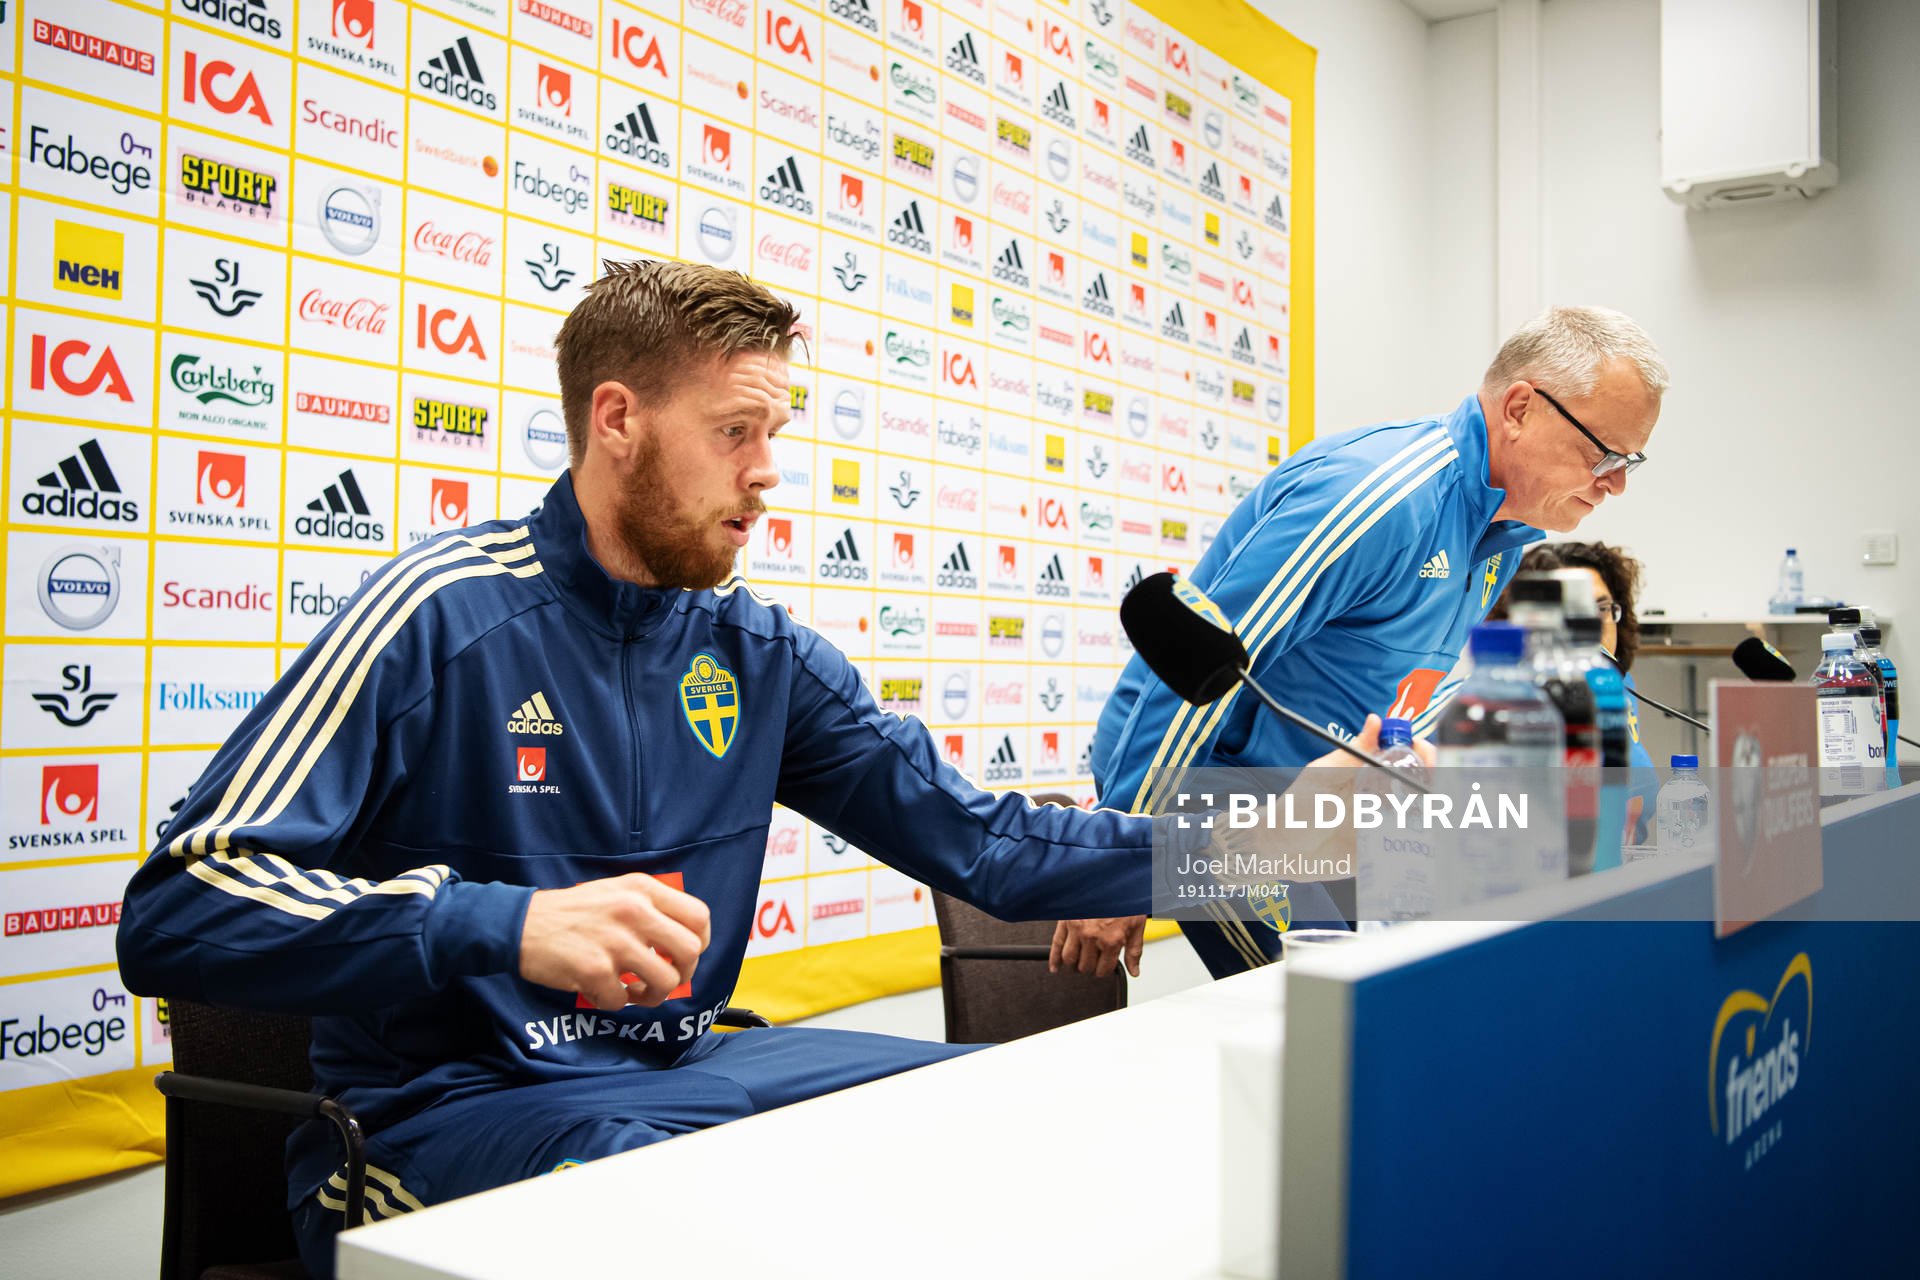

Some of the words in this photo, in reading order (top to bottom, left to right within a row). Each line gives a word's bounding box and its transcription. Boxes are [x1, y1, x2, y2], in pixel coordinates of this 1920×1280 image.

[34, 19, 154, 76] BAUHAUS
[612, 19, 667, 78] ICA
[766, 9, 813, 64] ICA
[1043, 19, 1073, 63] ICA
[308, 37, 364, 64] SVENSKA
[369, 57, 397, 76] SPEL
[183, 50, 273, 126] ICA
[418, 71, 497, 110] adidas
[303, 100, 398, 148] Scandic
[518, 108, 564, 131] SVENSKA
[566, 124, 589, 139] SPEL
[761, 90, 818, 128] Scandic
[606, 134, 670, 168] adidas
[827, 116, 881, 161] Fabege
[30, 125, 150, 194] Fabege
[182, 154, 277, 208] SPORT
[514, 161, 589, 214] Fabege
[186, 192, 272, 219] BLADET
[608, 184, 667, 224] SPORT
[760, 186, 813, 215] adidas
[543, 243, 559, 266] SJ
[887, 229, 931, 255] adidas
[215, 259, 239, 286] SJ
[845, 252, 857, 271] SJ
[417, 303, 486, 361] ICA
[1084, 329, 1112, 366] ICA
[30, 334, 134, 403] ICA
[170, 353, 274, 407] Carlsberg
[942, 350, 977, 389] ICA
[296, 392, 390, 424] BAUHAUS
[414, 398, 487, 437] SPORT
[22, 489, 138, 522] adidas
[169, 511, 234, 528] SVENSKA
[240, 516, 270, 530] SPEL
[1038, 497, 1068, 530] ICA
[295, 512, 384, 541] adidas
[820, 554, 869, 580] adidas
[51, 580, 109, 595] VOLVO
[163, 582, 273, 611] Scandic
[290, 582, 350, 617] Fabe
[62, 664, 91, 693] SJ
[690, 683, 728, 695] SVERIGE
[159, 682, 264, 712] Folksam
[507, 718, 563, 736] adidas
[508, 785, 537, 794] SVENSKA
[540, 785, 560, 794] SPEL
[9, 832, 84, 849] SVENSKA
[90, 829, 127, 844] SPEL
[0, 1014, 125, 1059] Fabege
[525, 1013, 665, 1050] SVENSKA
